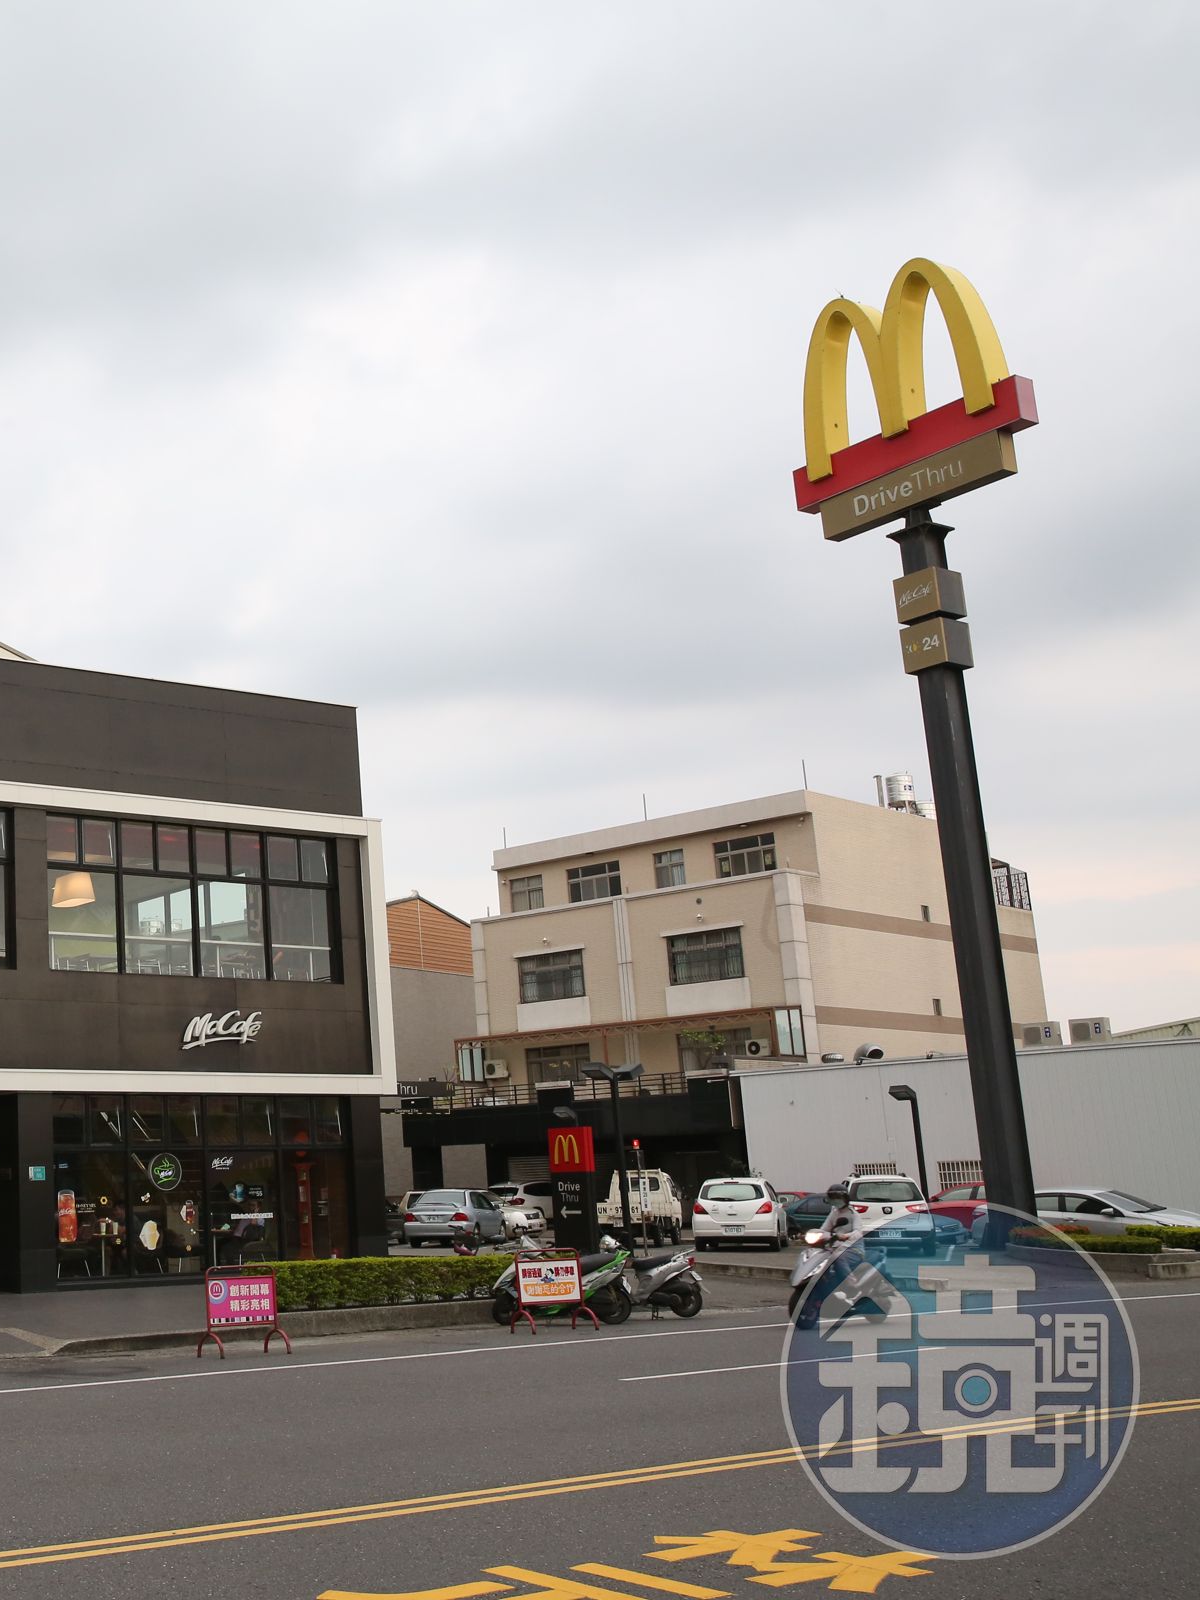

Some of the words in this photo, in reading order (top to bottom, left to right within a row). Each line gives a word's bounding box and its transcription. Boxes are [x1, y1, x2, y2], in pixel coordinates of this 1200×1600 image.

[922, 634, 940, 651] 24
[558, 1181, 581, 1191] Drive
[561, 1193, 579, 1202] Thru
